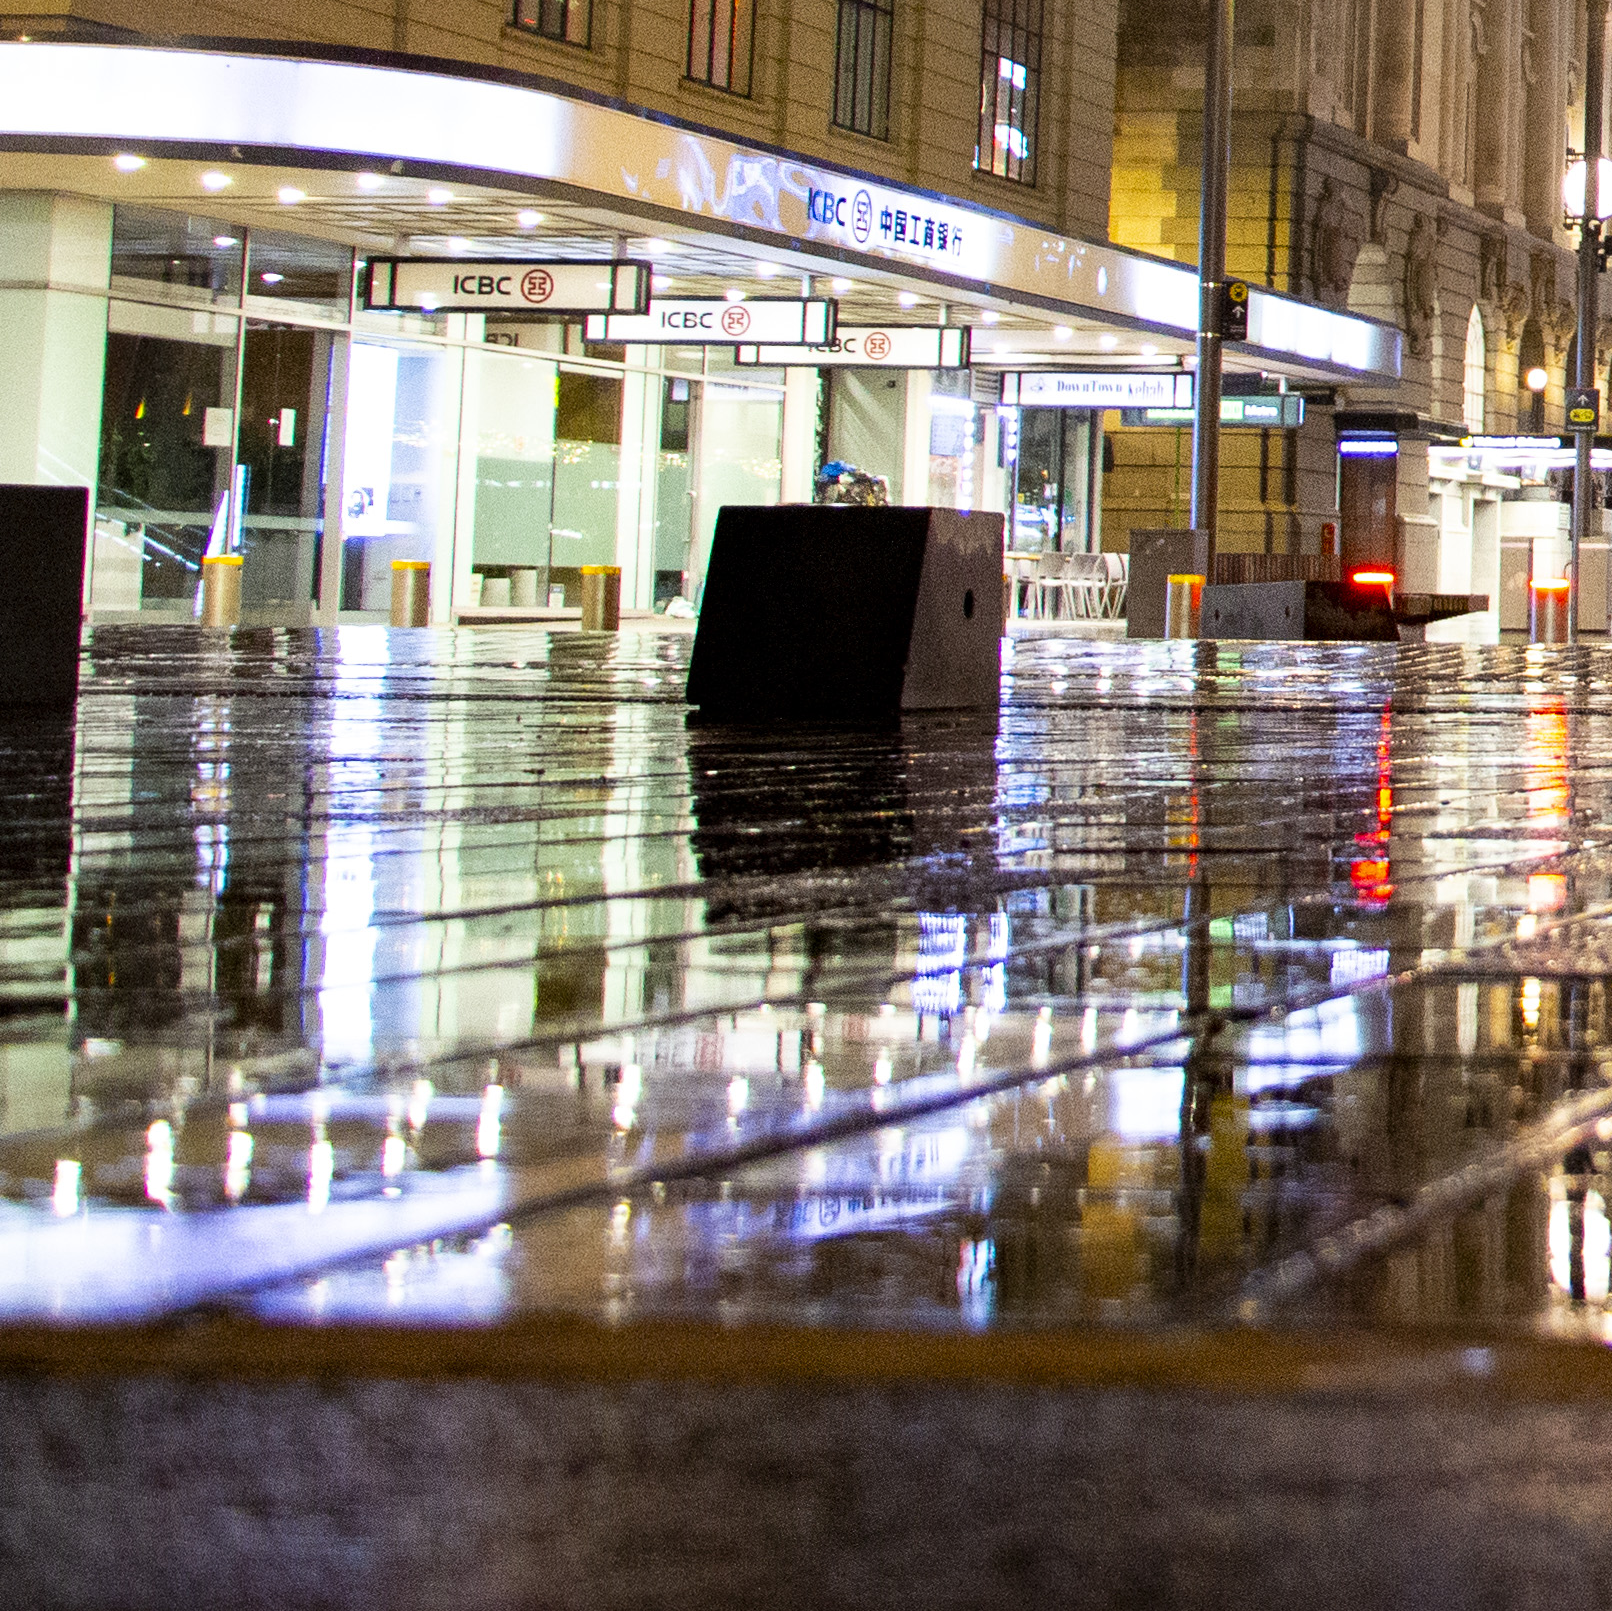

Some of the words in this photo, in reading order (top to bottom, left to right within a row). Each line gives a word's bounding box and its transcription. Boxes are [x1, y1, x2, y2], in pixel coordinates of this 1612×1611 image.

[806, 186, 848, 228] ICBC
[453, 274, 512, 296] ICBC
[660, 310, 713, 330] ICBC
